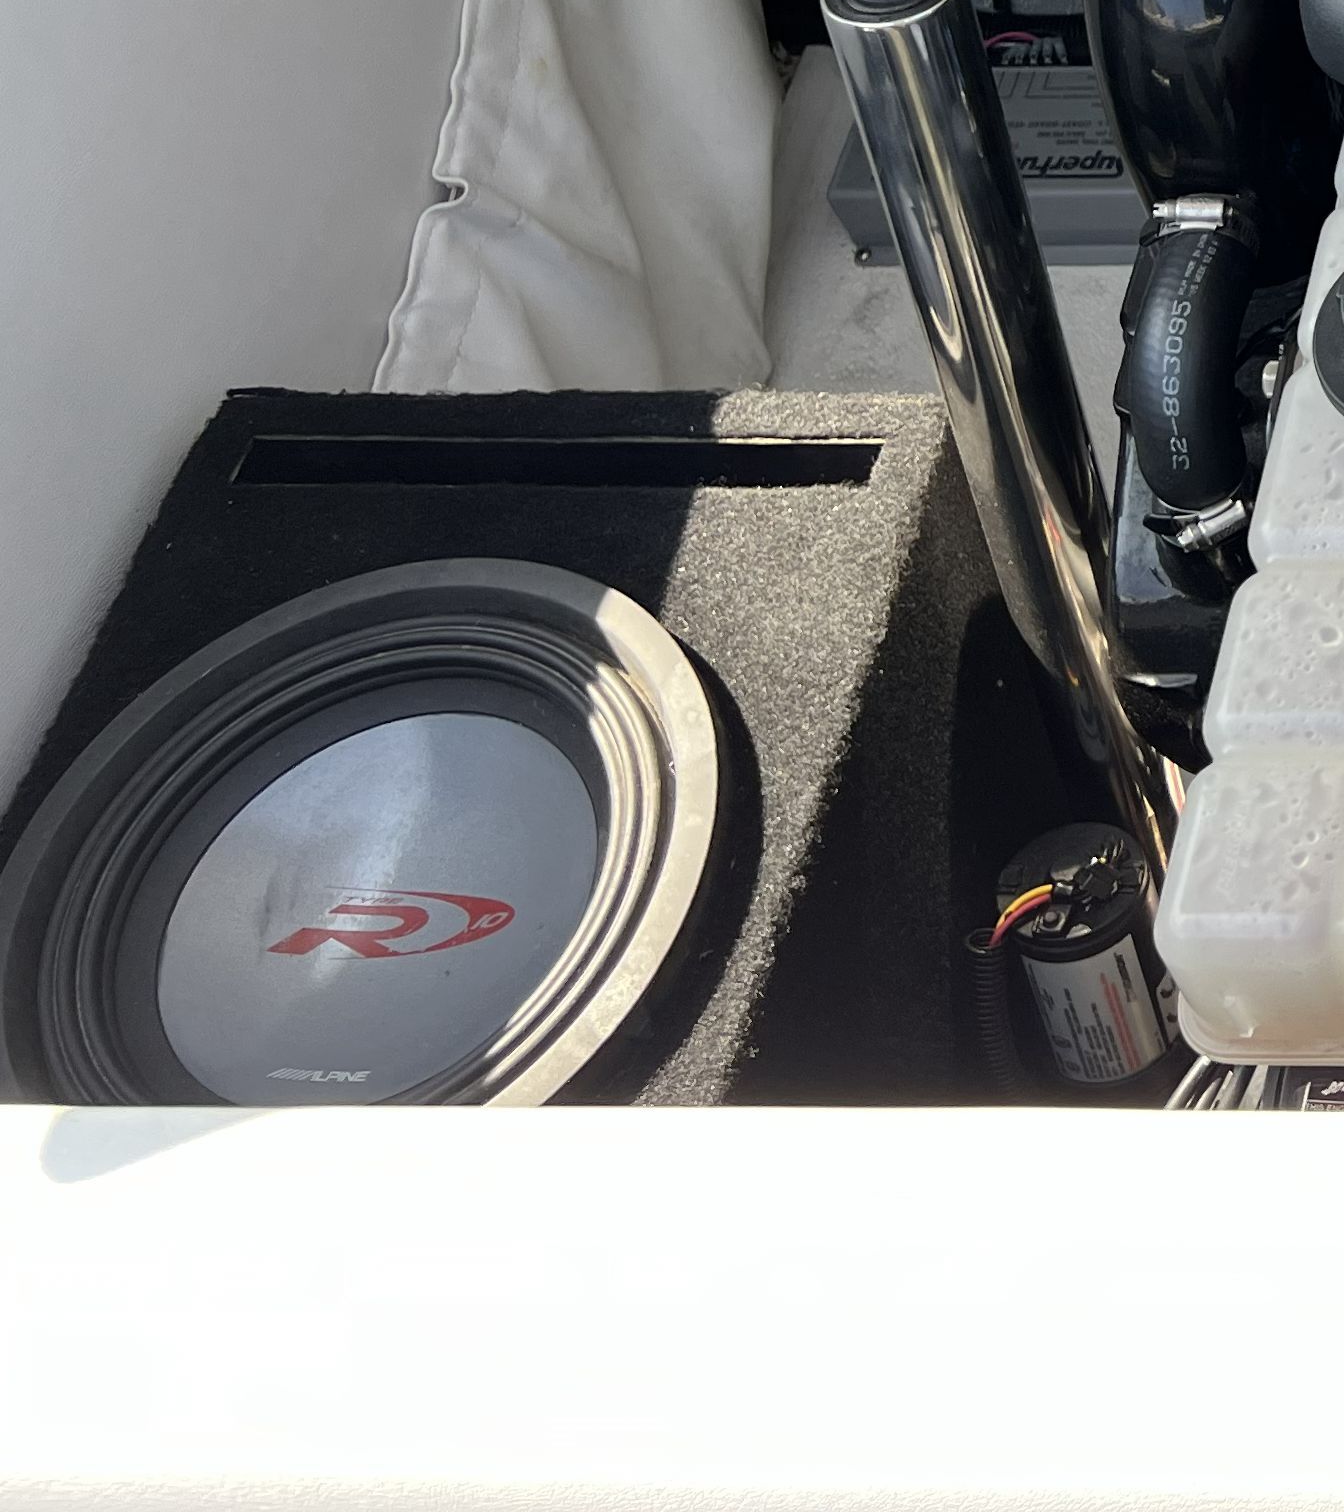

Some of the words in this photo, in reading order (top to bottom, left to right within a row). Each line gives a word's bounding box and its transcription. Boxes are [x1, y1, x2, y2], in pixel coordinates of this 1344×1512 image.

[1161, 300, 1191, 470] 32-863095
[469, 912, 509, 930] 10
[290, 1067, 372, 1083] ALPINE
